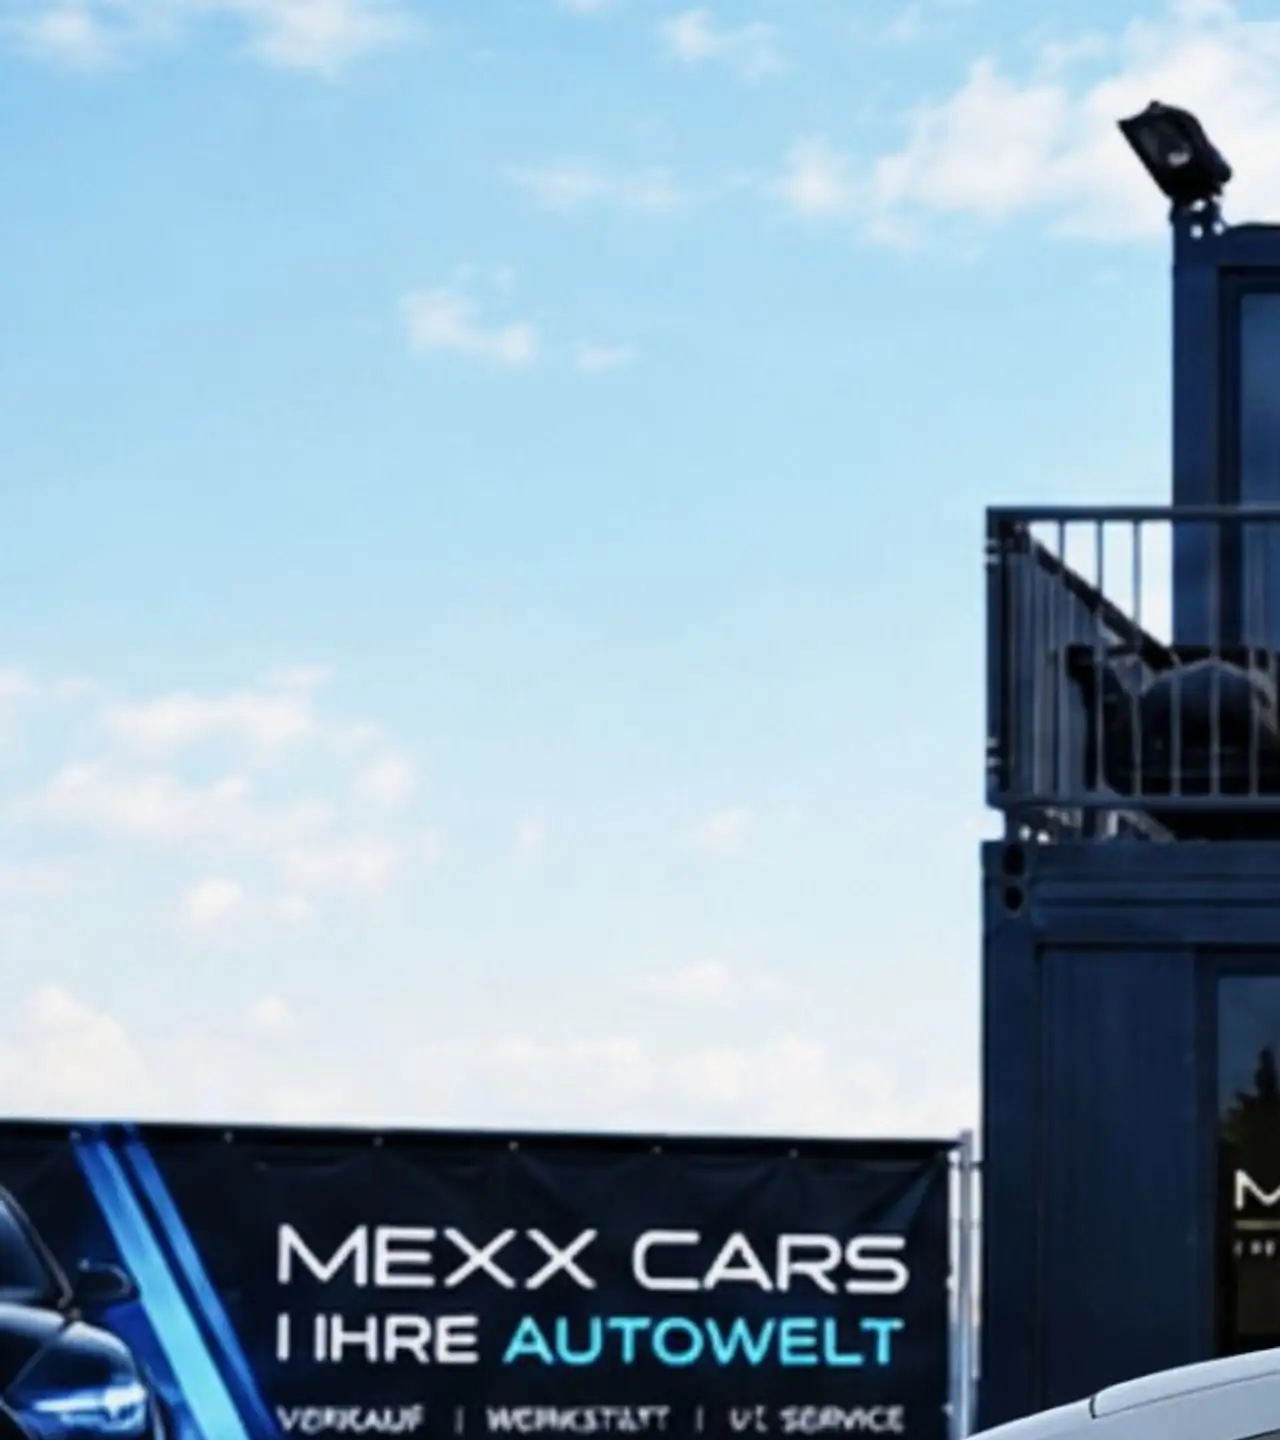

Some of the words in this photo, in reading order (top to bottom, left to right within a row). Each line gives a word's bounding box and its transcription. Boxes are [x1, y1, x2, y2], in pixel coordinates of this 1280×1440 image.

[277, 1223, 597, 1290] MEXX
[632, 1229, 909, 1294] CARS
[314, 1313, 479, 1364] IHRE
[503, 1316, 904, 1366] AUTOWELT
